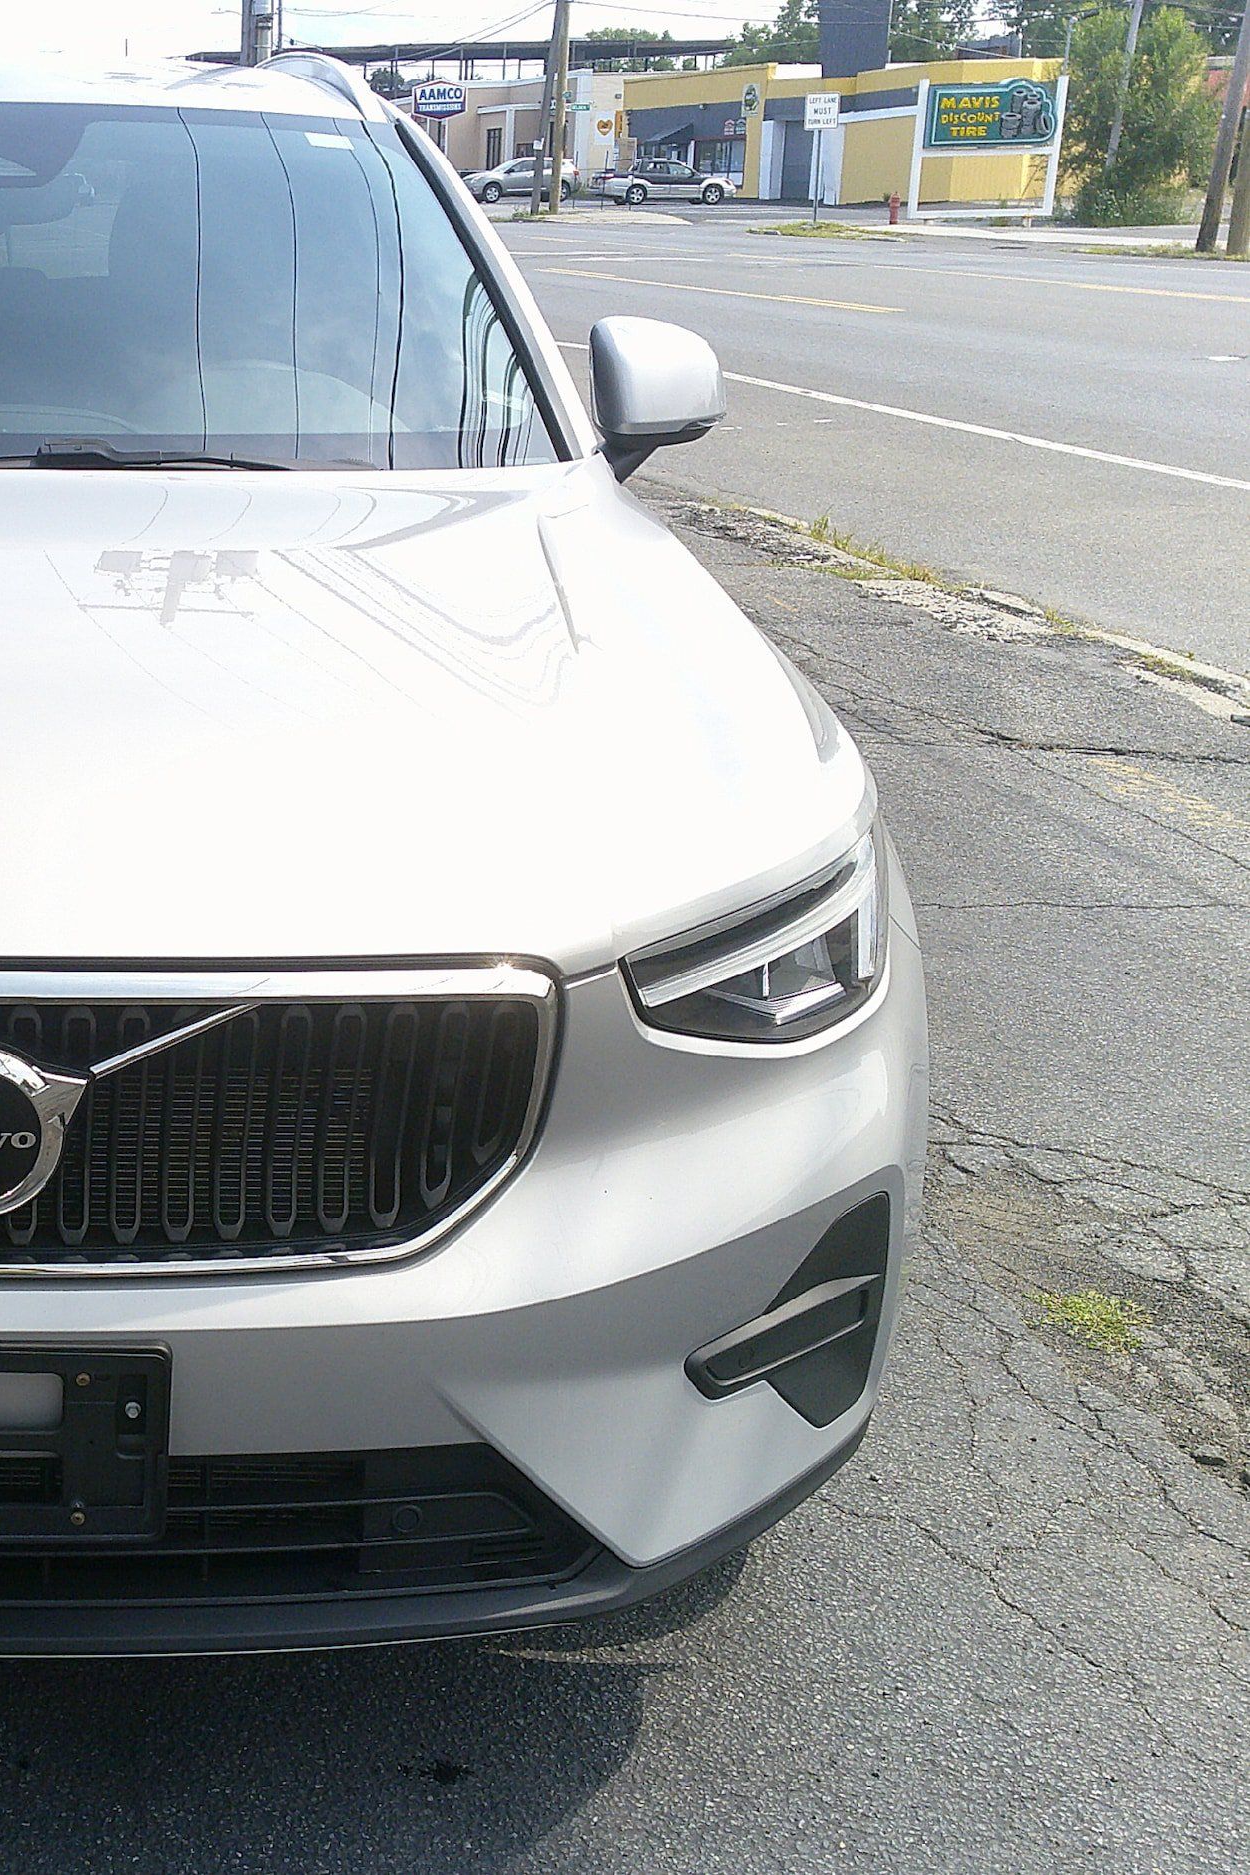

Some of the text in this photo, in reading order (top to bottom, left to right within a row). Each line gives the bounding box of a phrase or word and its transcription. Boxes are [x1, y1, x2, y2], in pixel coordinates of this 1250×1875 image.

[419, 87, 463, 101] AAMCO
[823, 96, 837, 104] LANE
[940, 96, 1000, 109] MAVIS
[813, 107, 831, 115] MUST
[940, 112, 1001, 124] DISCOUNT
[950, 126, 988, 137] TIRE
